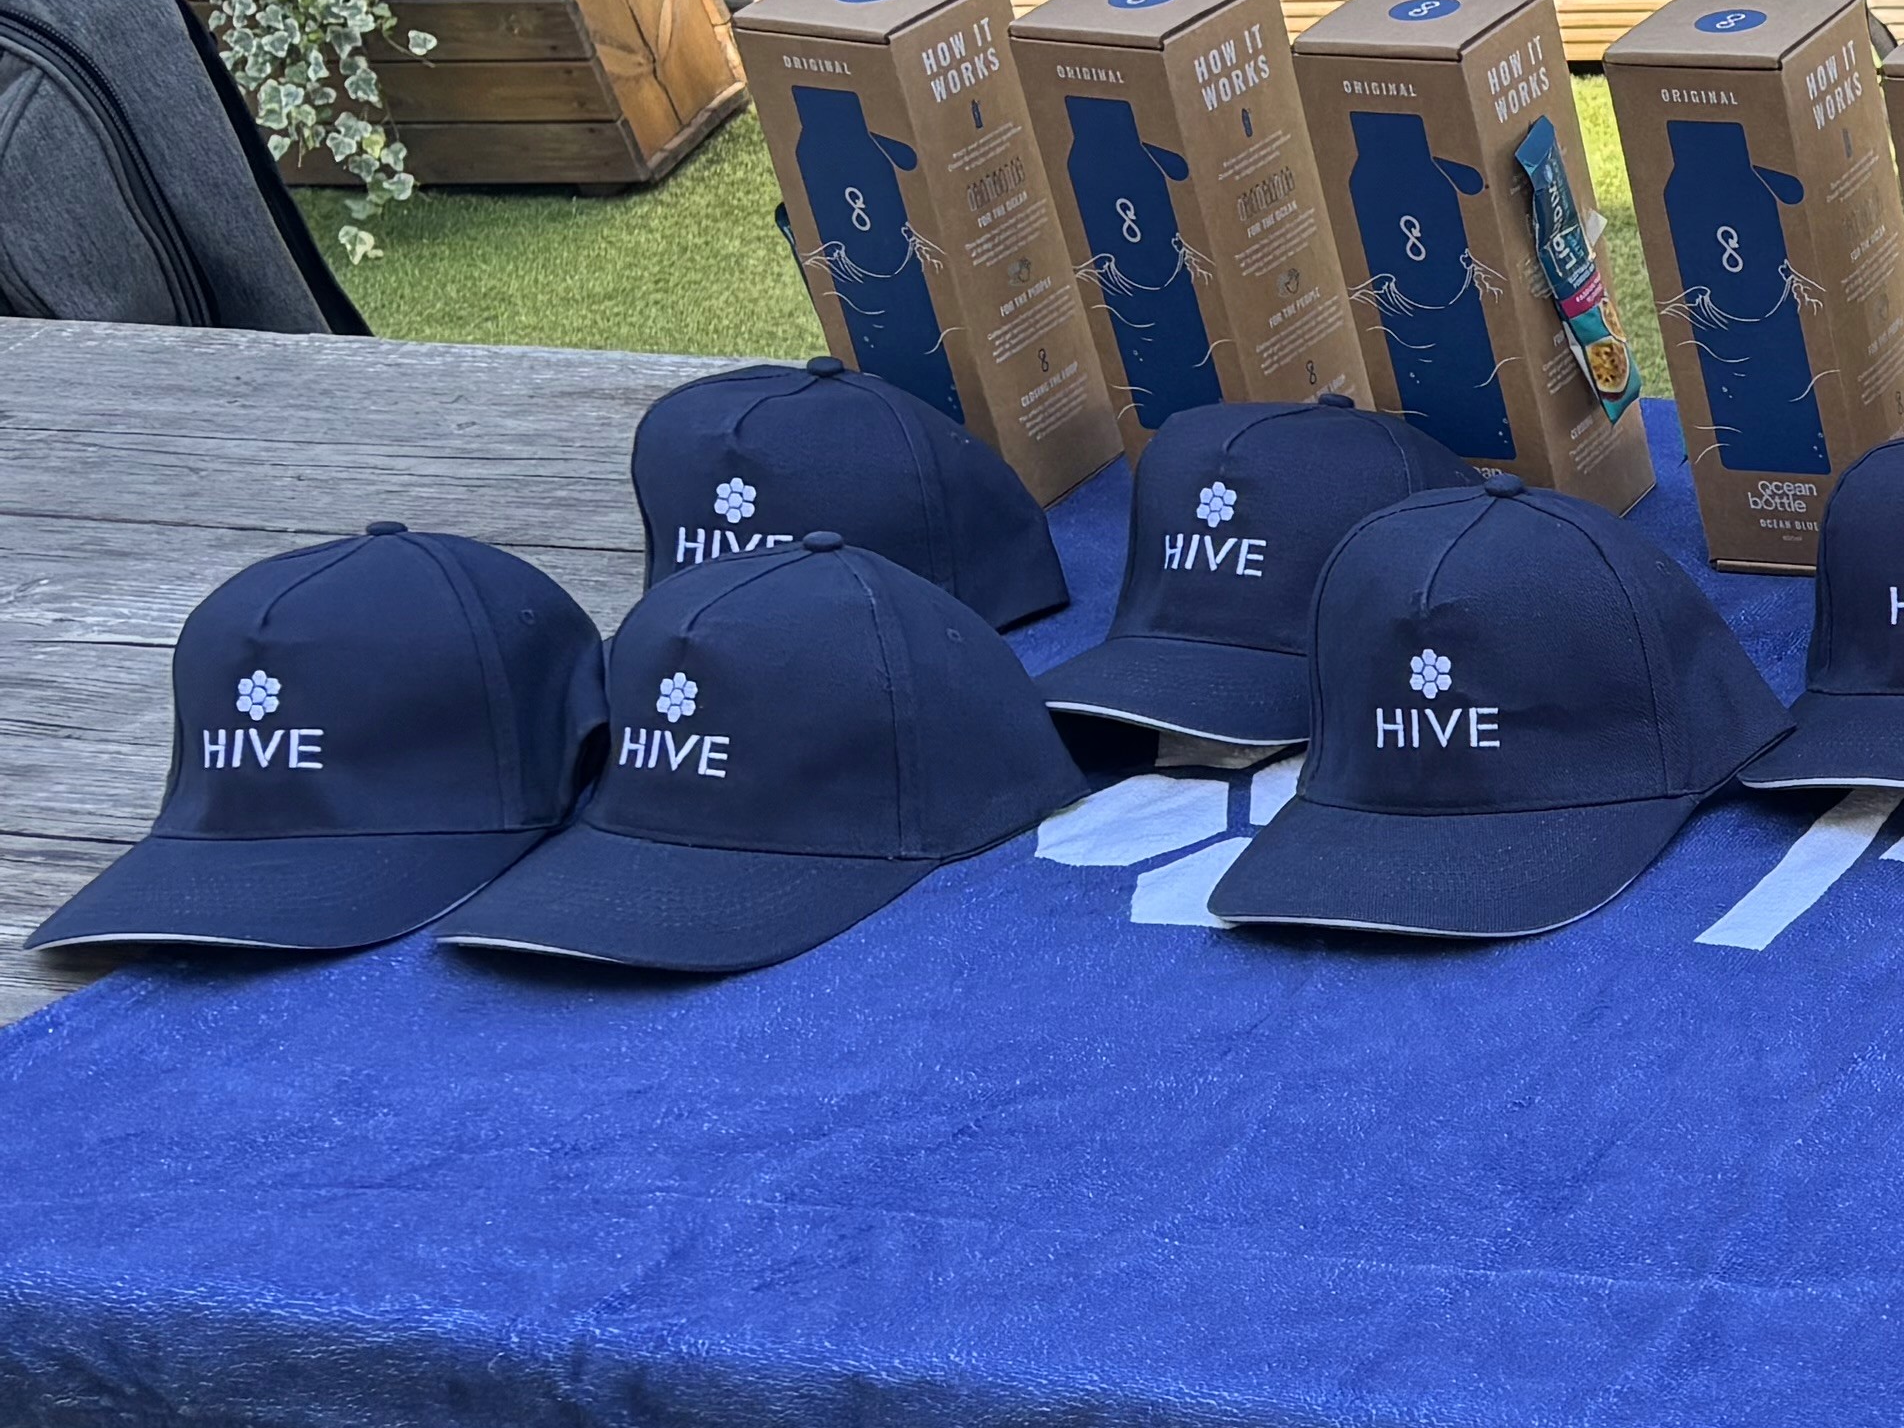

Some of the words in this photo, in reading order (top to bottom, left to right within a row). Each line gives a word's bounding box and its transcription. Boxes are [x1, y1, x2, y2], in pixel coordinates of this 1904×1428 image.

[782, 55, 851, 75] ORIGINAL
[922, 32, 966, 75] HOW
[973, 17, 991, 47] IT
[1193, 40, 1237, 83] HOW
[1244, 24, 1263, 53] IT
[1487, 50, 1523, 95] HOW
[1527, 35, 1543, 65] IT
[1806, 55, 1838, 100] HOW
[1842, 40, 1857, 70] IT
[930, 47, 1000, 103] WORKS
[1201, 54, 1270, 112] WORKS
[1343, 80, 1417, 97] ORIGINAL
[1494, 67, 1550, 123] WORKS
[1660, 89, 1738, 105] ORIGINAL
[1812, 72, 1863, 130] WORKS
[1748, 492, 1807, 512] bottle
[1758, 481, 1818, 497] ocean
[1165, 533, 1267, 577] HIVE
[203, 727, 324, 770] HIVE
[618, 725, 730, 778] HIVE
[1376, 706, 1501, 749] HIVE
